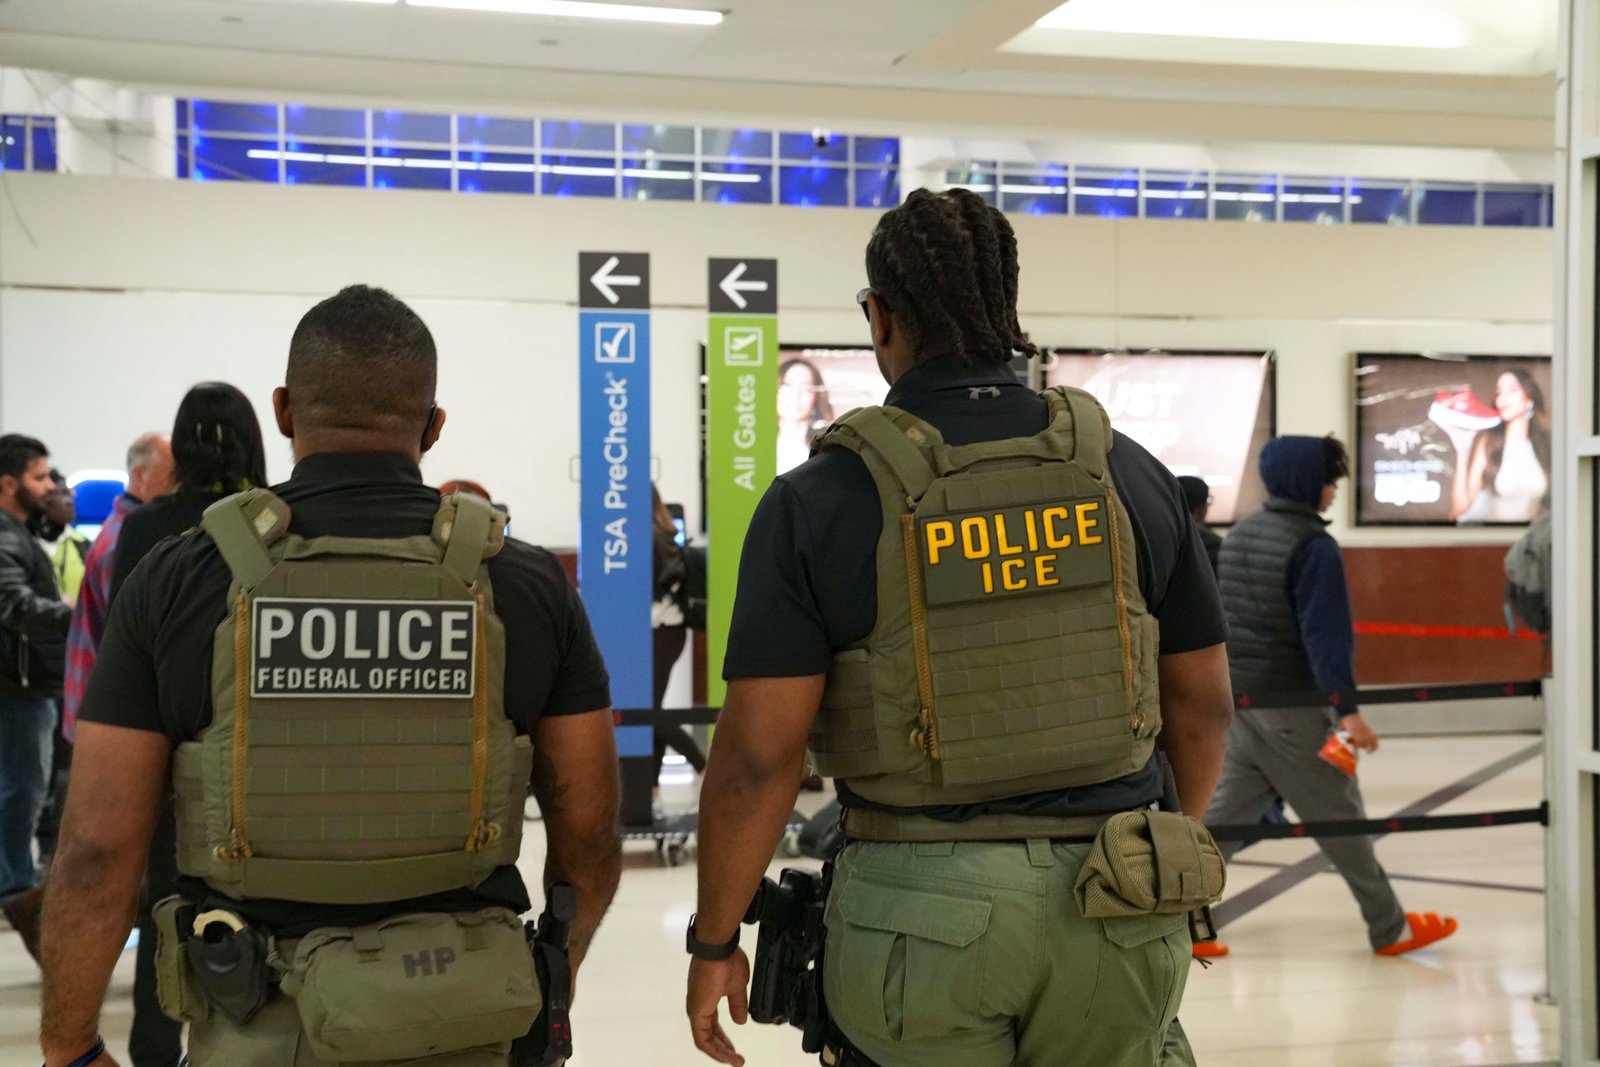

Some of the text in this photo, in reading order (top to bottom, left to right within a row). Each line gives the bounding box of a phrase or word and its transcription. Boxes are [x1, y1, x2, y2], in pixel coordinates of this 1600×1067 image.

[734, 374, 756, 490] All Gates
[604, 517, 628, 574] TSA
[926, 502, 1103, 565] POLICE
[981, 554, 1060, 594] ICE
[259, 608, 469, 660] POLICE
[258, 667, 467, 690] FEDERAL OFFICER
[402, 947, 456, 978] HP
